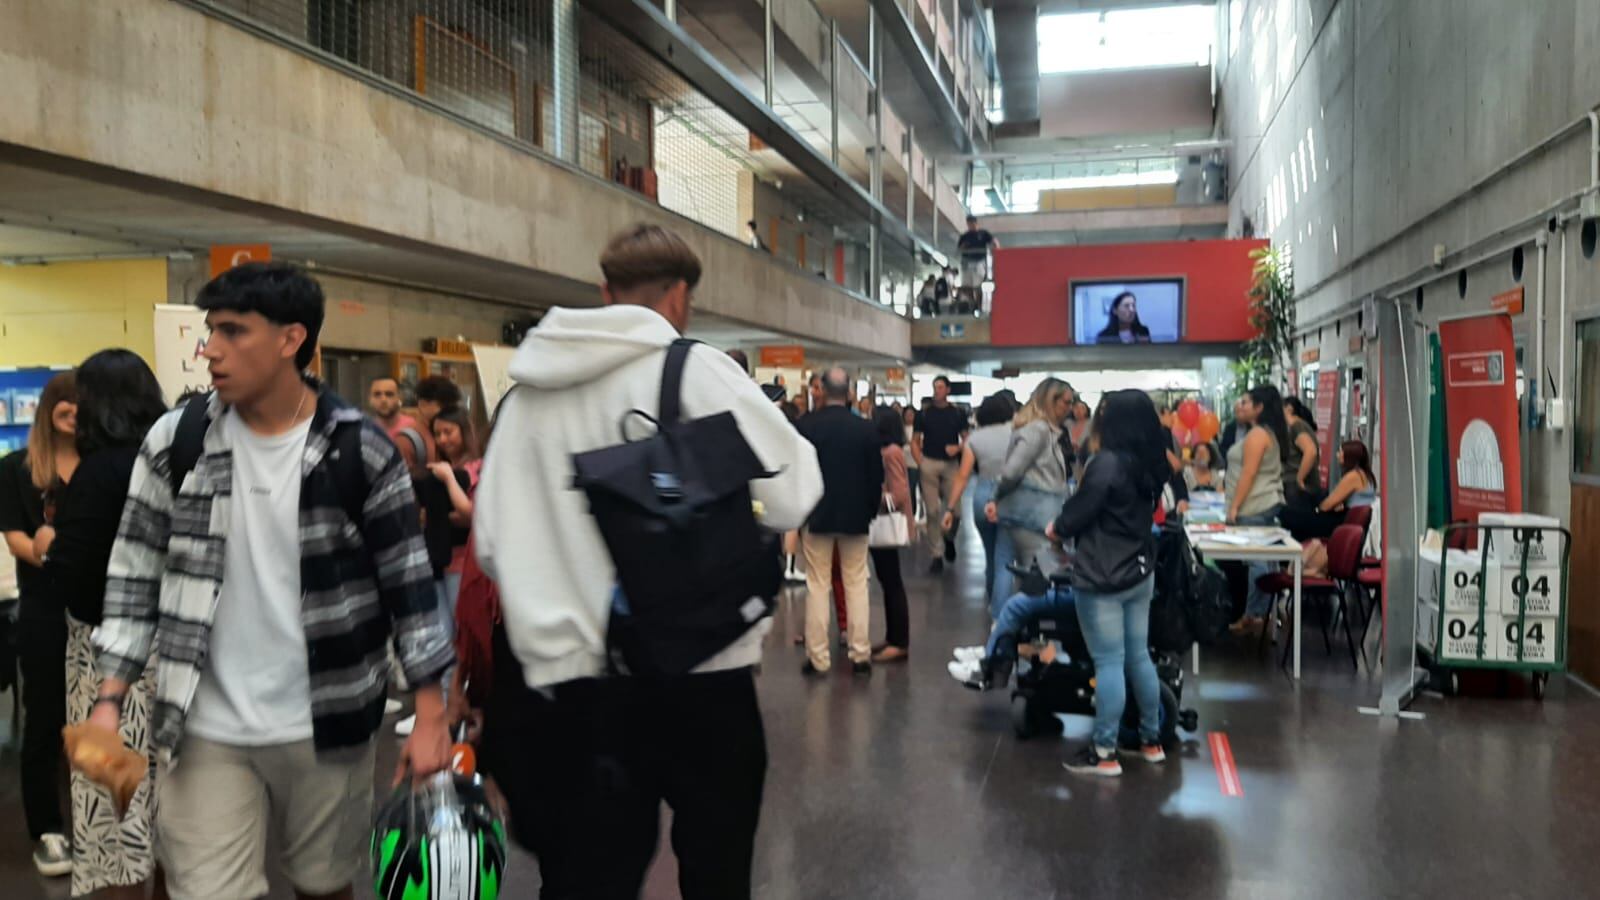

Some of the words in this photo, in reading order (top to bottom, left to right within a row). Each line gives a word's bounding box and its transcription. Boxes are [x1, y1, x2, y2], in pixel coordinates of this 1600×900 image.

[1454, 571, 1482, 589] 04
[1511, 575, 1550, 598] 04
[1448, 619, 1487, 641] 04
[1505, 622, 1545, 645] 04
